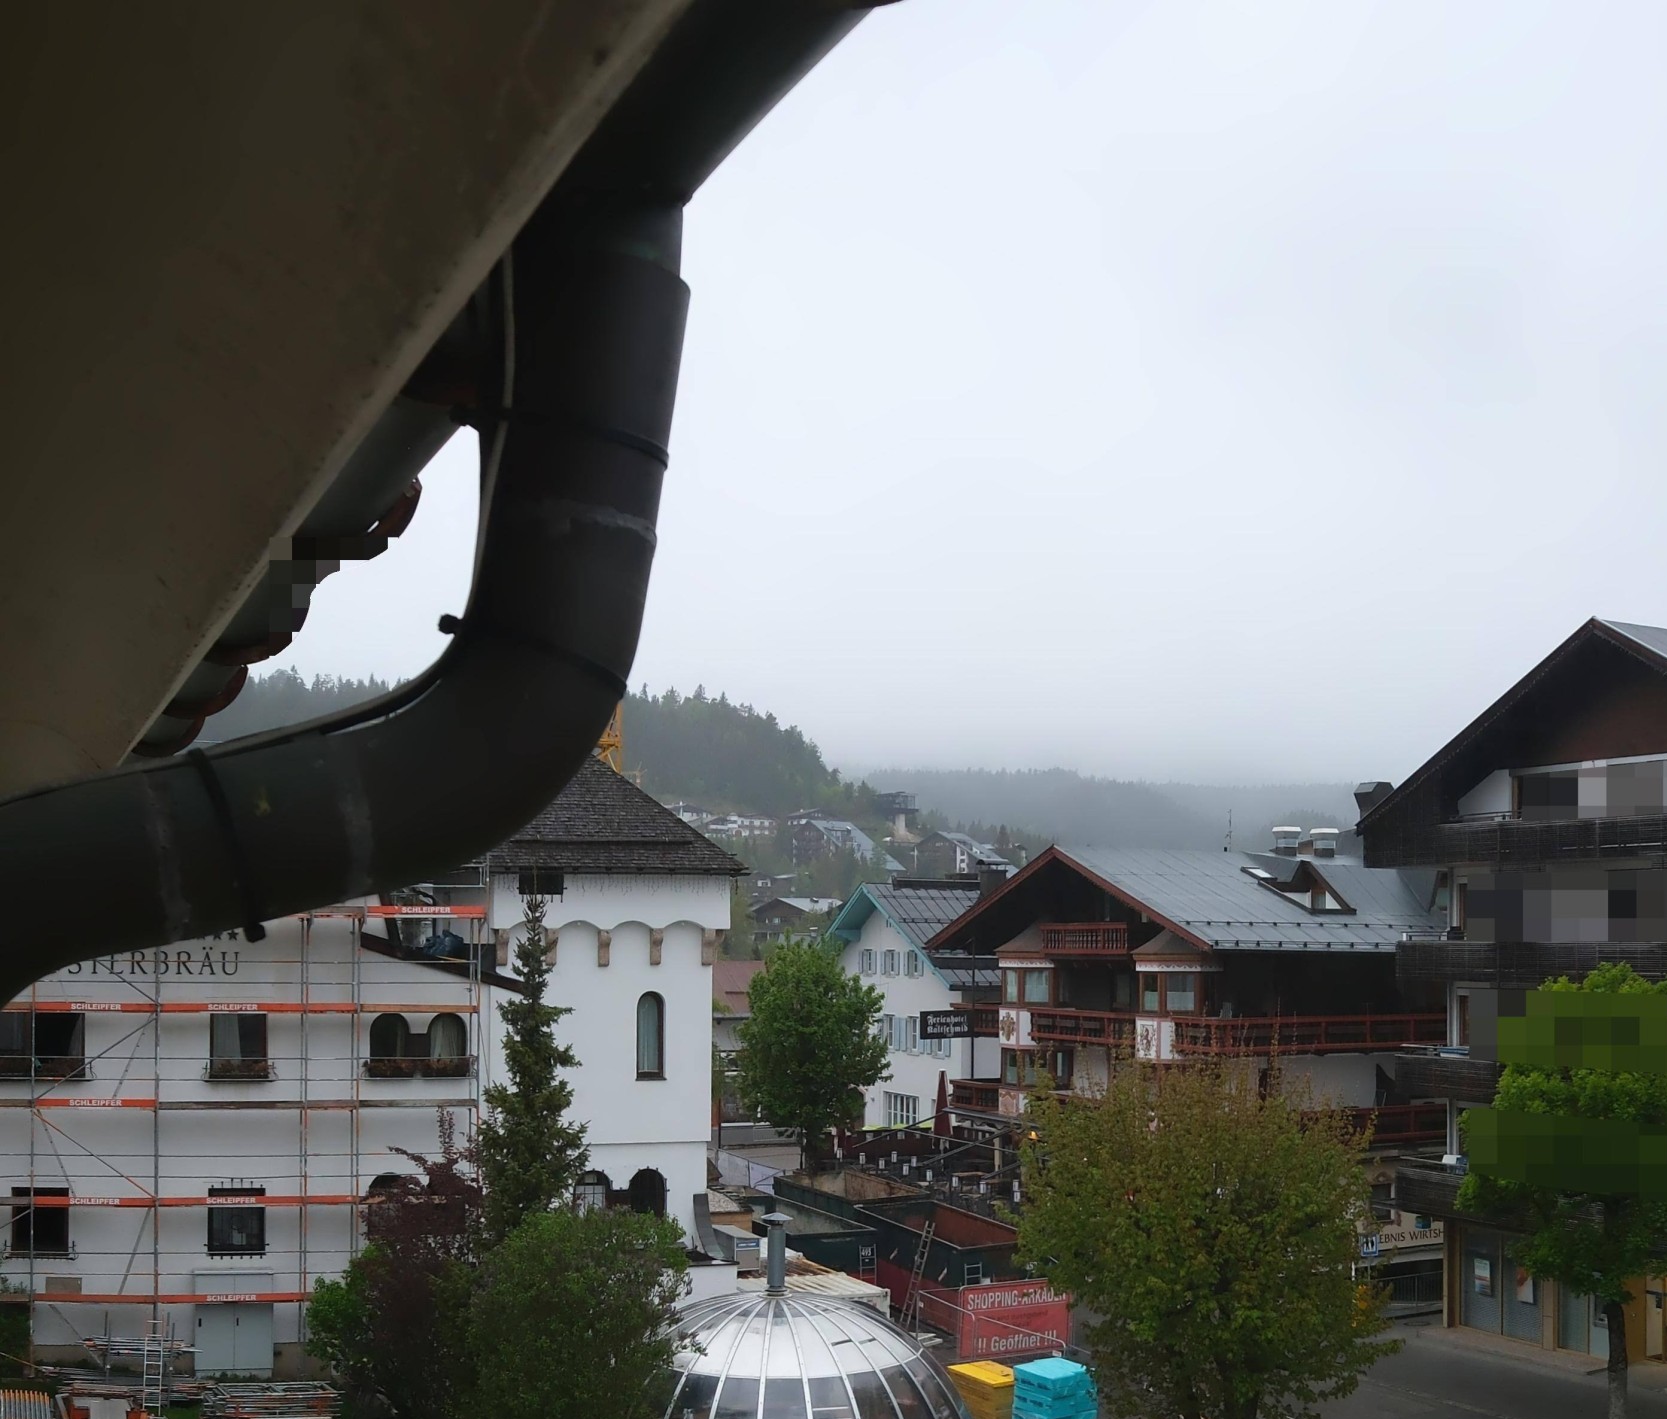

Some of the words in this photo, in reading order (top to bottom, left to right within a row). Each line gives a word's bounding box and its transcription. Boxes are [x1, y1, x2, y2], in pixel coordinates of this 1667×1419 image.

[401, 906, 451, 914] SCHLEIPFER
[70, 1002, 122, 1011] SCHLEIPFER
[207, 1003, 258, 1011] SCHLEIPFER
[69, 1099, 122, 1107] SCHLEIPFER
[69, 1197, 121, 1206] SCHLEIPFER
[206, 1196, 256, 1205] SCHLEIPFER
[206, 1294, 257, 1302] SCHLEIPFER
[991, 1333, 1041, 1352] Geöffnet
